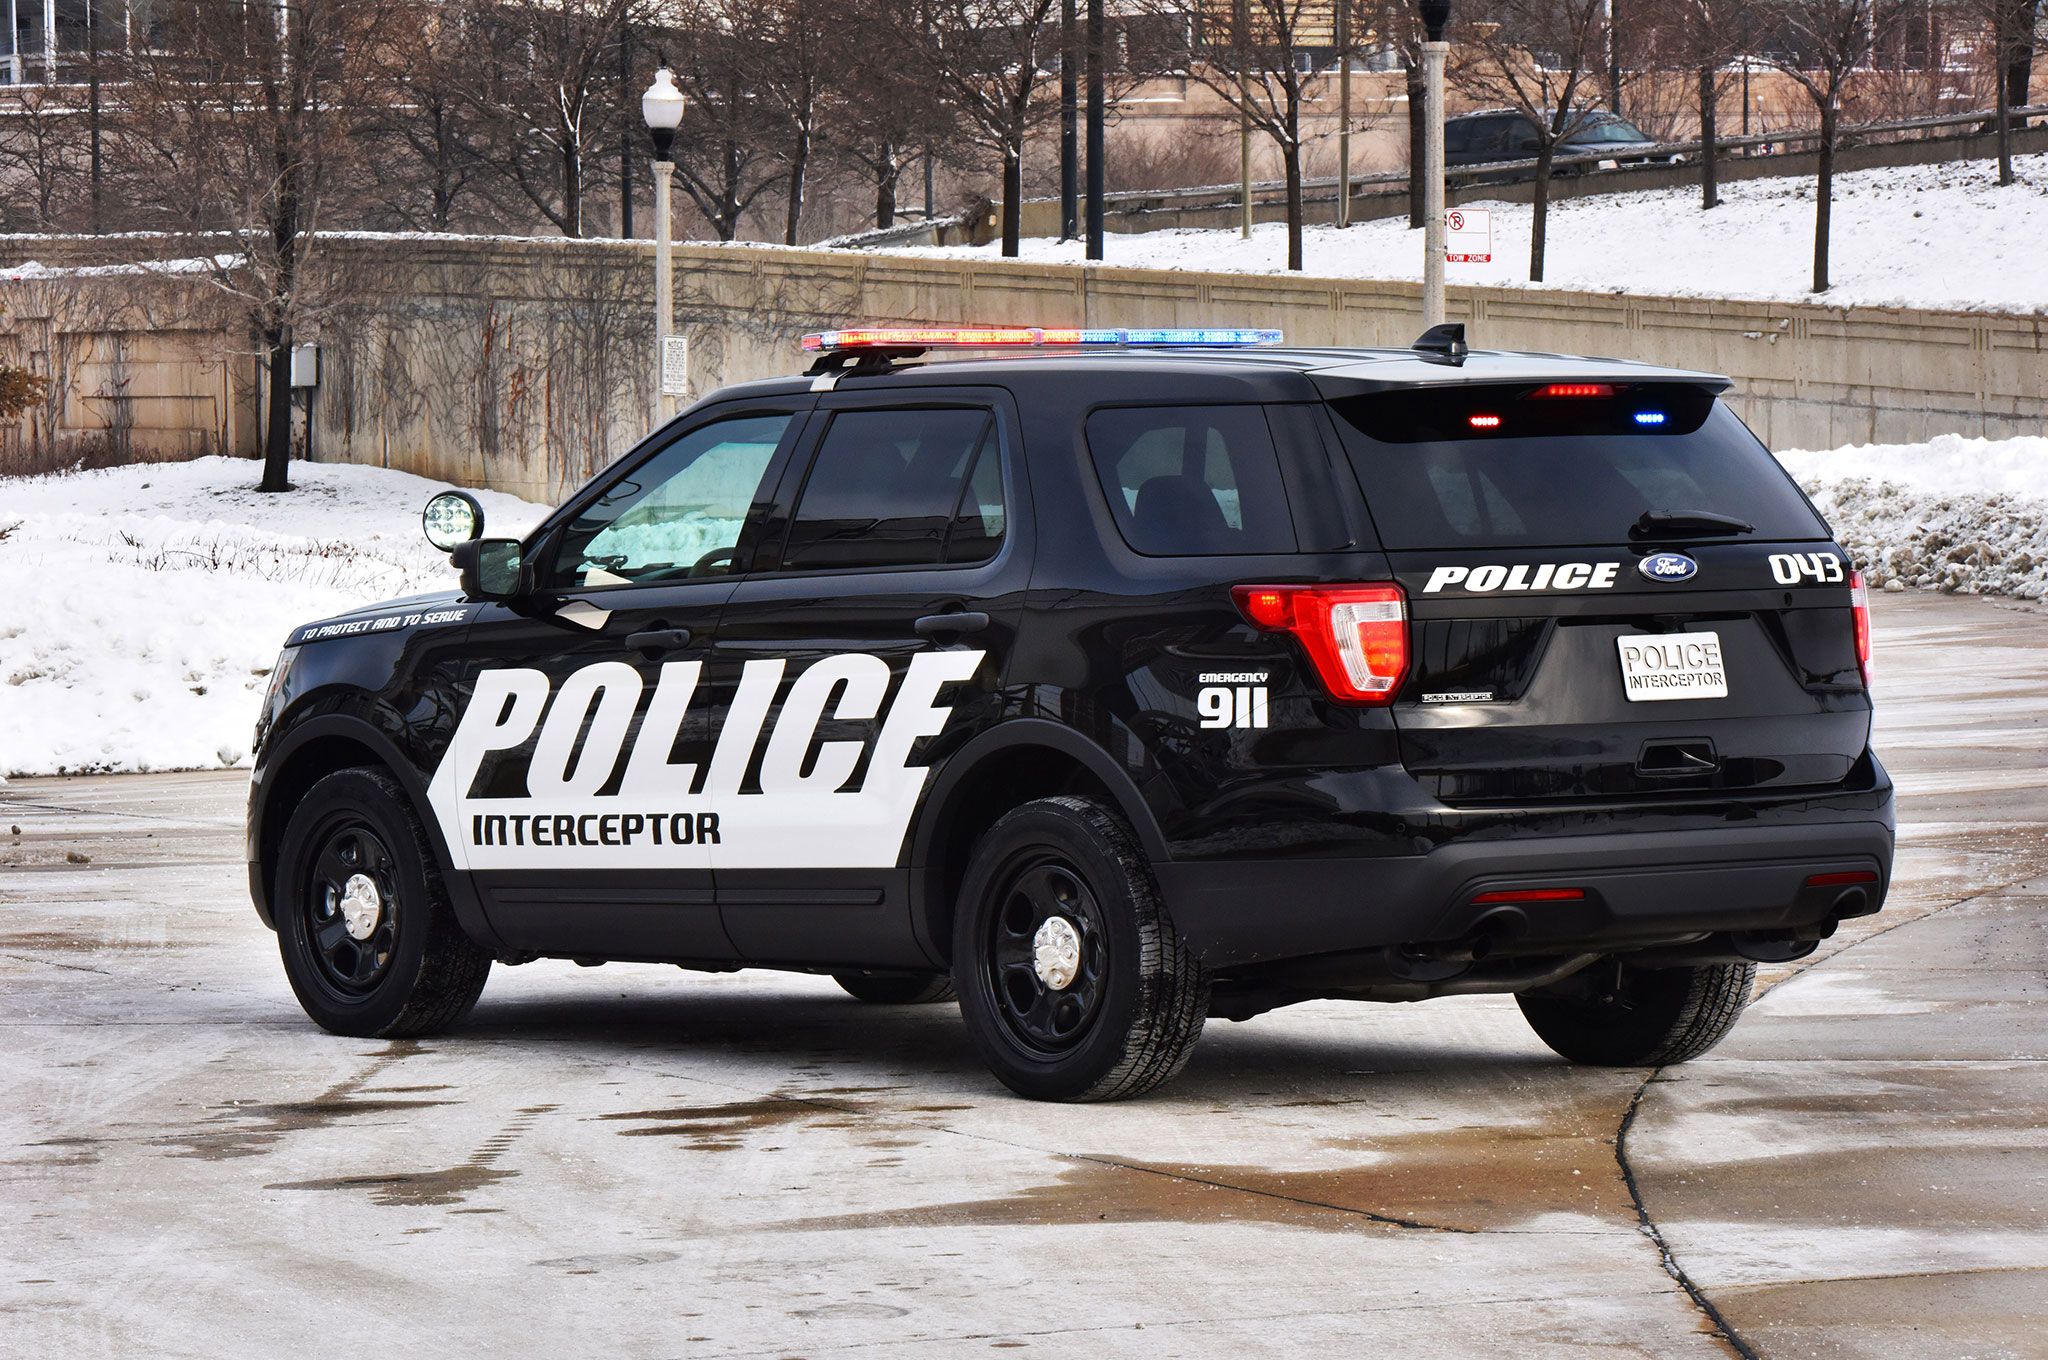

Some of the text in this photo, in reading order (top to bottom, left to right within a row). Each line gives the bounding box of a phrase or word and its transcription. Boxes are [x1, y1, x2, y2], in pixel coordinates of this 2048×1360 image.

[1449, 254, 1487, 262] TOW ZONE
[1422, 562, 1620, 593] POLICE
[1655, 557, 1687, 576] Ford
[1767, 552, 1844, 585] 043
[301, 610, 468, 640] TO PROTECT AND TO SERVE
[1623, 643, 1721, 672] POLICE
[1198, 673, 1269, 683] EMERGENCY
[1629, 672, 1723, 689] INTERCEPTOR
[1198, 687, 1269, 729] 911
[465, 650, 986, 800] POLICE
[472, 812, 721, 846] INTERCEPTOR
